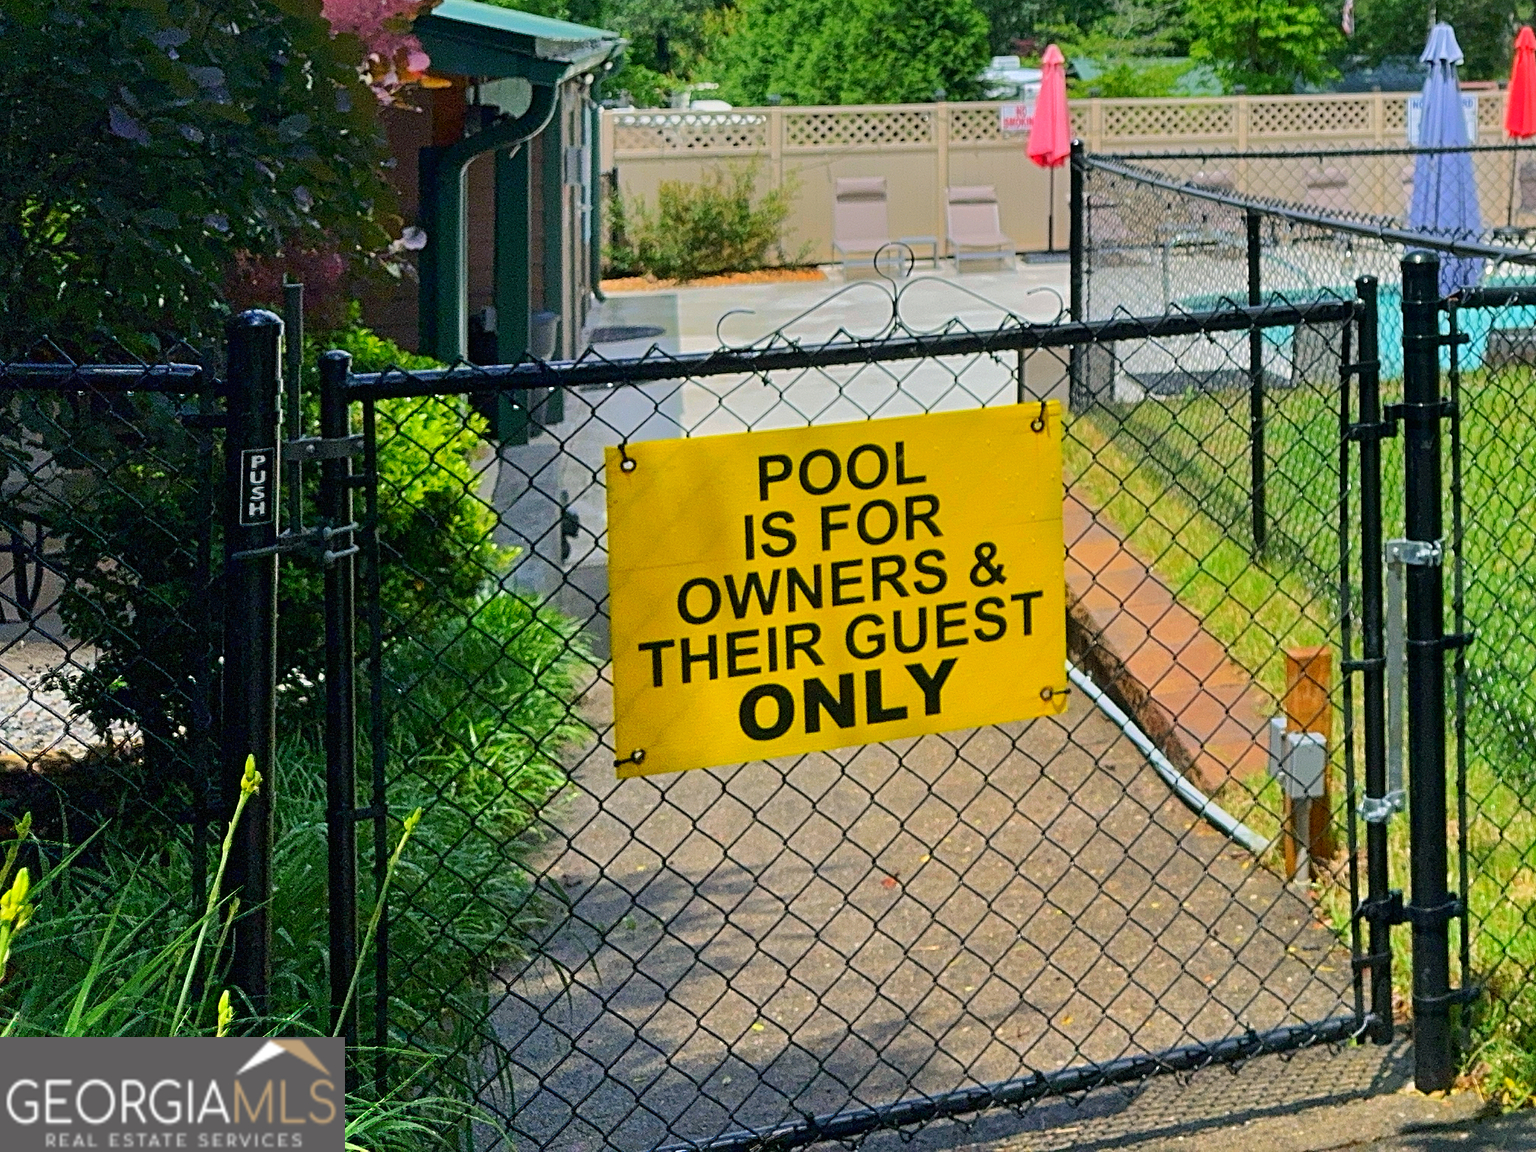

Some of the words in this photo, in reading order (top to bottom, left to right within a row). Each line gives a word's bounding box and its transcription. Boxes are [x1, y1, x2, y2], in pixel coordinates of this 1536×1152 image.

[248, 454, 266, 517] PUSH
[758, 441, 927, 502] POOL
[744, 510, 797, 561] IS
[820, 493, 943, 552] FOR
[677, 549, 948, 625] OWNERS
[969, 541, 1007, 588] &
[637, 622, 825, 688] THEIR
[845, 590, 1044, 660] GUEST
[738, 657, 958, 741] ONLY
